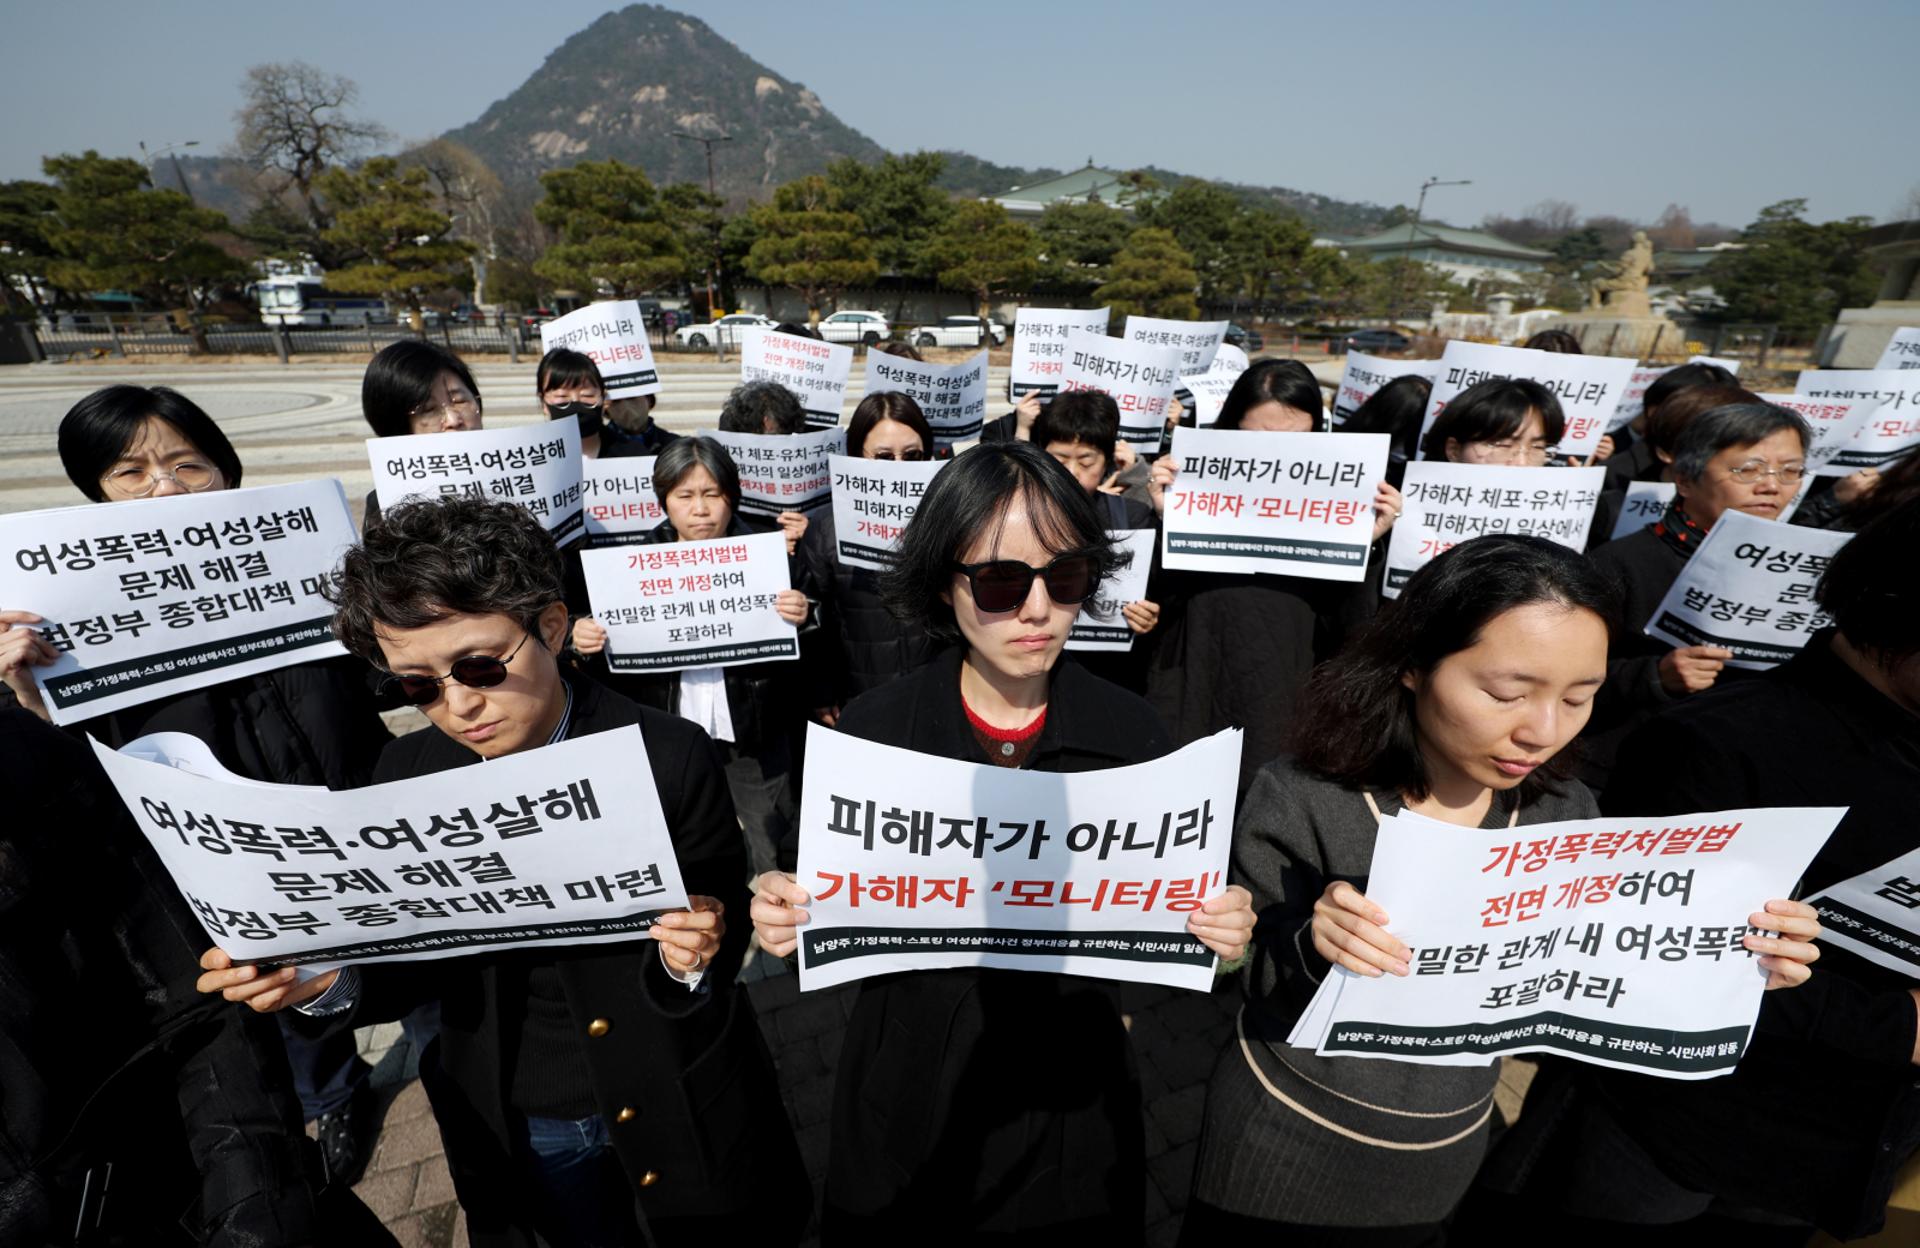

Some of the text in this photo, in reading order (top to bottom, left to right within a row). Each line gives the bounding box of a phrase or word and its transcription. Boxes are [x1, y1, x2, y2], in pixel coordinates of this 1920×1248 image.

[591, 319, 634, 340] 아니라
[1028, 342, 1064, 357] 피해자
[1072, 352, 1138, 383] 피해자가
[935, 391, 961, 404] 해결
[924, 406, 962, 419] 합대책
[387, 438, 567, 480] 여성폭력·여성살해
[777, 459, 829, 479] 일상에서
[1182, 456, 1365, 488] 피해자가 아니라
[490, 473, 536, 498] 해결
[553, 483, 580, 509] 마련
[835, 473, 886, 496] 가해자
[1407, 483, 1473, 507] 가해자
[1173, 491, 1244, 518] 가해자
[857, 521, 904, 540] 가해자
[1422, 512, 1510, 536] 피해자의
[15, 507, 319, 575] 여성폭력·여성살해
[628, 544, 748, 571] 가정폭력처벌법
[119, 551, 272, 601] 문제 해결
[640, 571, 745, 597] 전면 개정하여
[40, 610, 151, 652] 범정부
[159, 579, 296, 629] 종합대책
[661, 601, 695, 620] 관계
[700, 598, 716, 616] 내
[1683, 587, 1772, 626] 범정부
[668, 622, 733, 643] 포괄하라
[140, 778, 602, 862] 여성폭력·여성살해
[827, 794, 1214, 861] 피해자가 아니라
[1481, 822, 1742, 877] 가정폭력처벌법
[267, 852, 517, 904] 문제 해결
[814, 871, 1220, 912] 가해자 '모니터링'
[186, 863, 667, 941] 범정부 종합대책 마련
[1479, 868, 1695, 928] 전면 개정하여
[813, 937, 851, 954] 남양주
[854, 936, 943, 946] 가정폭력·스토킹
[946, 936, 1018, 947] 여성살해사건
[1021, 938, 1080, 948] 정부대응을
[1084, 939, 1130, 950] 규탄하는
[1133, 942, 1180, 953] 시민사회
[1408, 943, 1490, 976] 밀한
[1497, 931, 1556, 969] 관계
[1564, 922, 1604, 957] 내
[1481, 968, 1626, 1011] 포괄하라
[1337, 1023, 1738, 1059] 남양주 가정폭력·스토킹 여성살해사건 정부대응을 규탄하는 시민사회 일동
